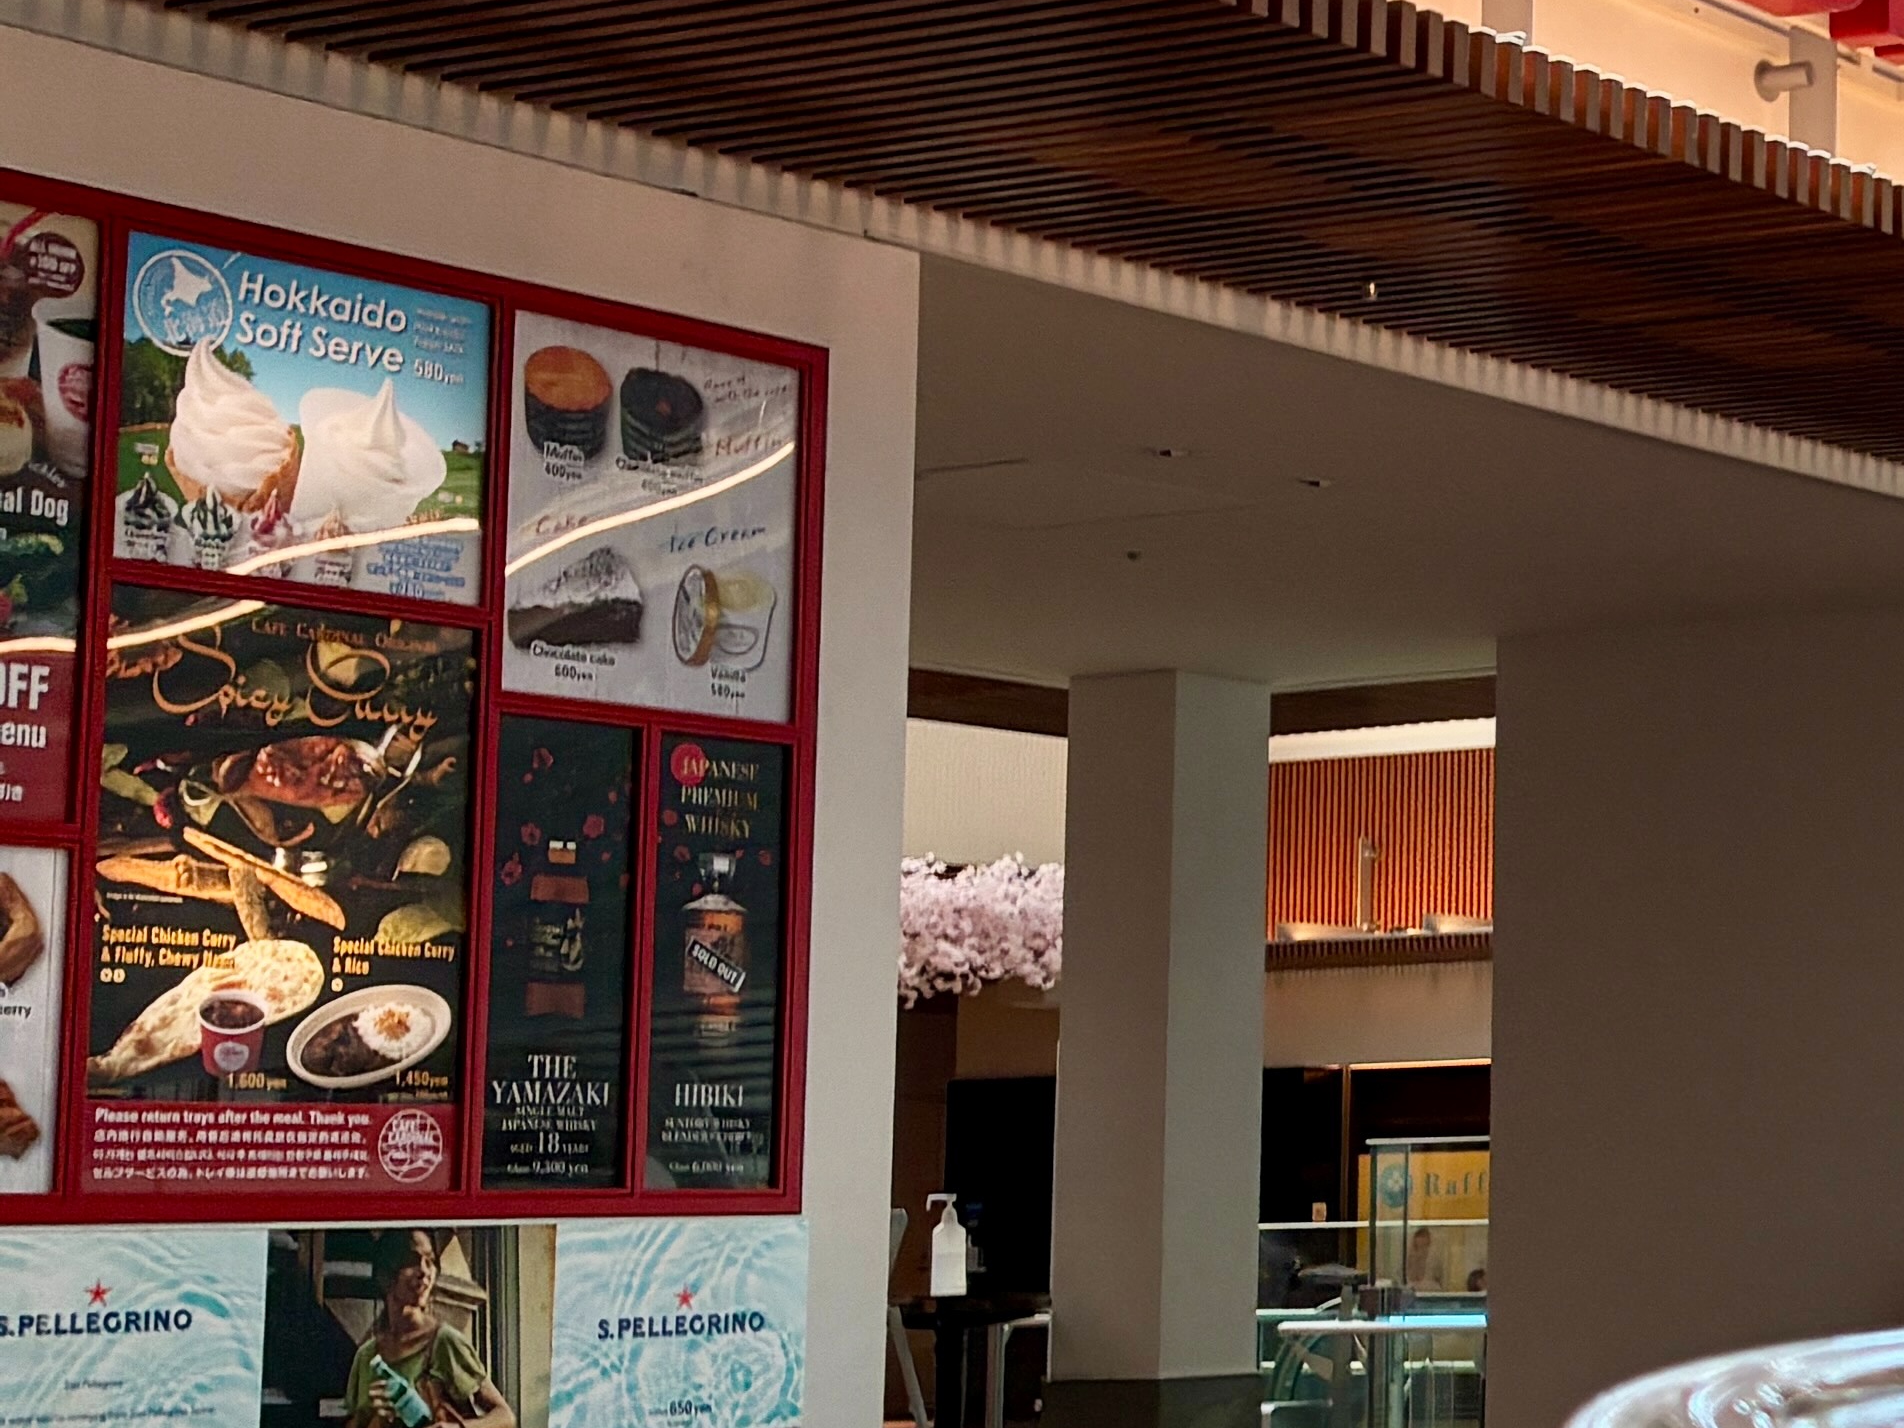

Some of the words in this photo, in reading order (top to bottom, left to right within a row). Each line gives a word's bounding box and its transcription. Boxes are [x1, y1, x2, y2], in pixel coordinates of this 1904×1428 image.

[237, 271, 407, 333] Hokkaido
[236, 311, 302, 354] Soft
[309, 325, 404, 372] Serve
[0, 486, 23, 513] al
[30, 488, 69, 526] Dog
[669, 534, 696, 553] Ice
[705, 525, 766, 547] Cream
[152, 623, 292, 727] Spicy
[306, 642, 438, 742] Curry
[0, 722, 47, 748] enu
[683, 756, 759, 781] JAPANESE
[681, 785, 757, 810] PREMIUM
[685, 813, 750, 839] WHISKY
[102, 924, 148, 945] Special
[151, 926, 199, 946] Chicken
[202, 928, 236, 951] Curry
[333, 936, 374, 957] Special
[378, 938, 421, 957] Chicken
[424, 942, 455, 962] Curry
[692, 944, 718, 970] SOLD
[717, 962, 738, 983] OUT
[527, 1054, 577, 1079] THE
[492, 1080, 609, 1106] YAMAZAKI
[675, 1083, 743, 1107] HIBIKI
[95, 1107, 139, 1123] Please
[141, 1109, 180, 1123] return
[183, 1110, 215, 1126] trays
[218, 1109, 247, 1124] after
[250, 1110, 271, 1124] the
[309, 1110, 345, 1125] Thank
[539, 1131, 560, 1154] 18
[0, 1309, 192, 1337] S.PELLEGRINO
[597, 1311, 765, 1340] S.PELLEGRINO
